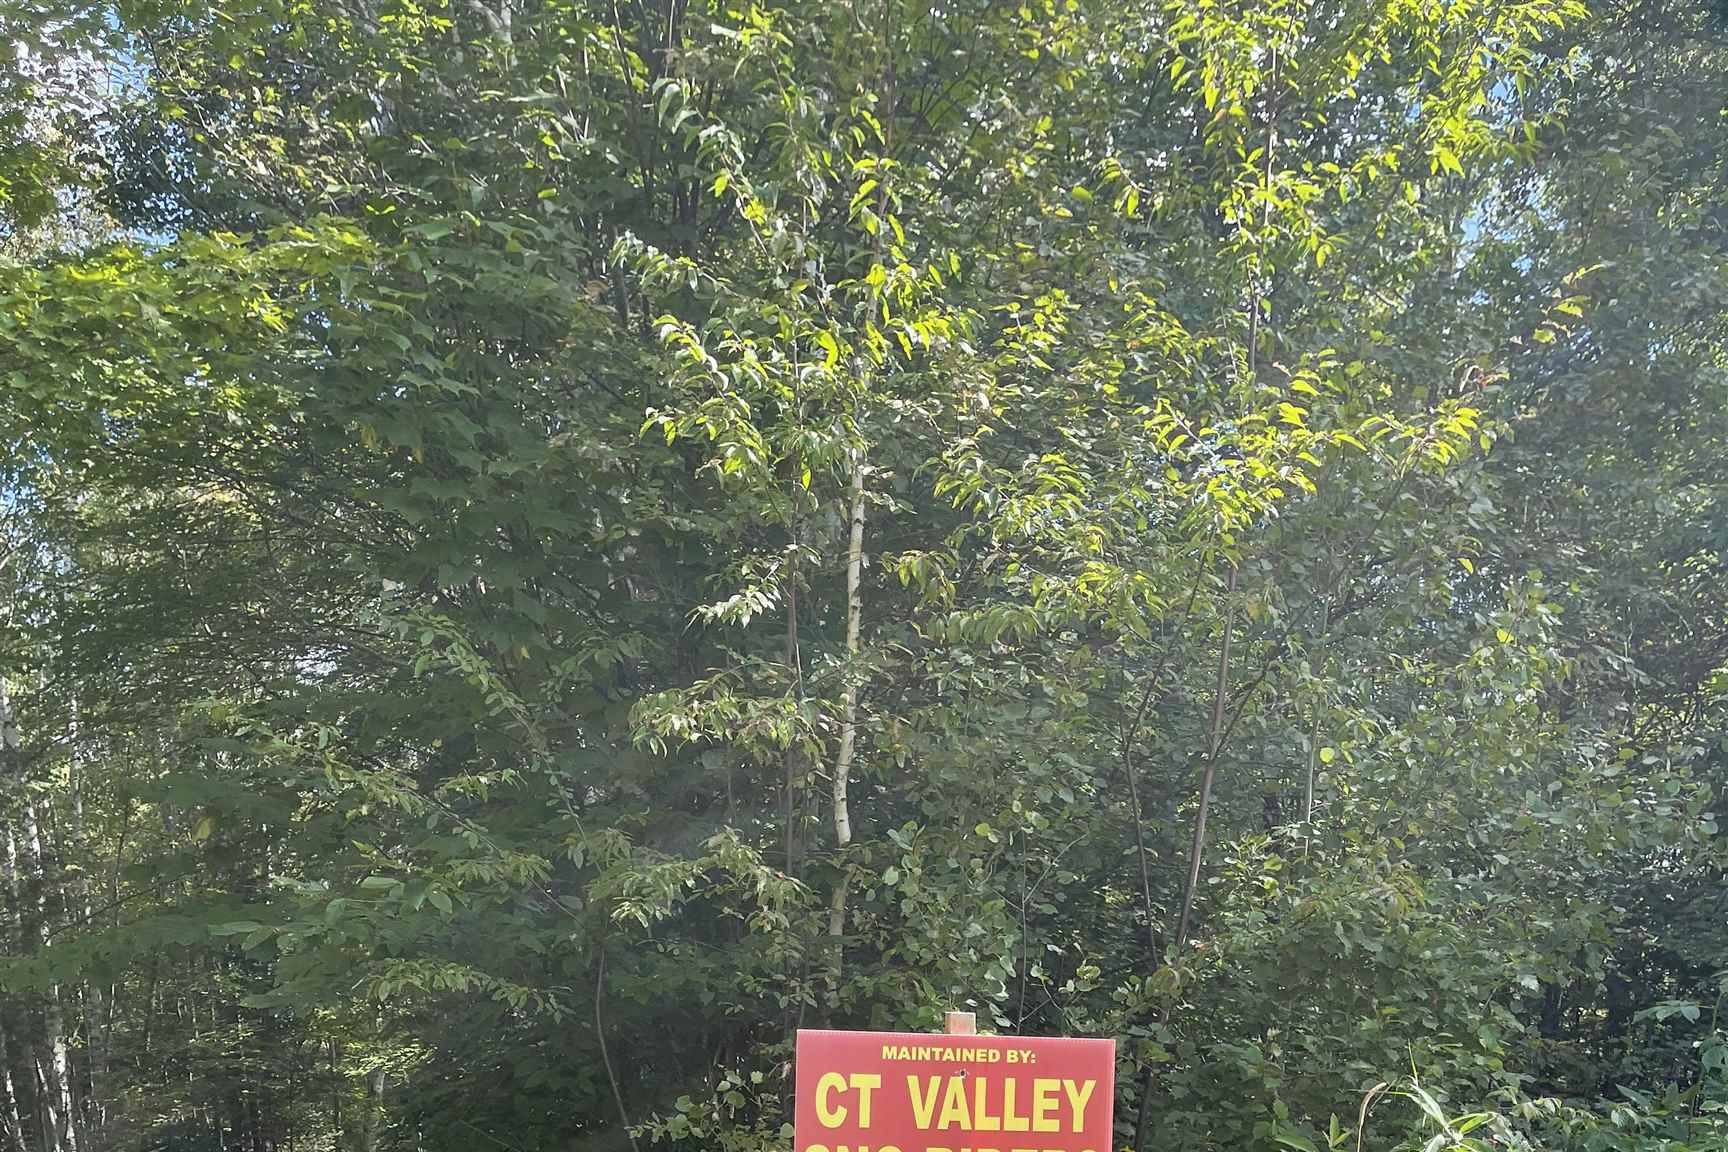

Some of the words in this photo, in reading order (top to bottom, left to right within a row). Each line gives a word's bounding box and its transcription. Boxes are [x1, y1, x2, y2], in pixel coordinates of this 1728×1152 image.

[882, 1046, 1000, 1062] MAINTAINED
[1006, 1050, 1036, 1064] BY:
[815, 1072, 881, 1129] CT
[907, 1075, 1097, 1133] VALLEY
